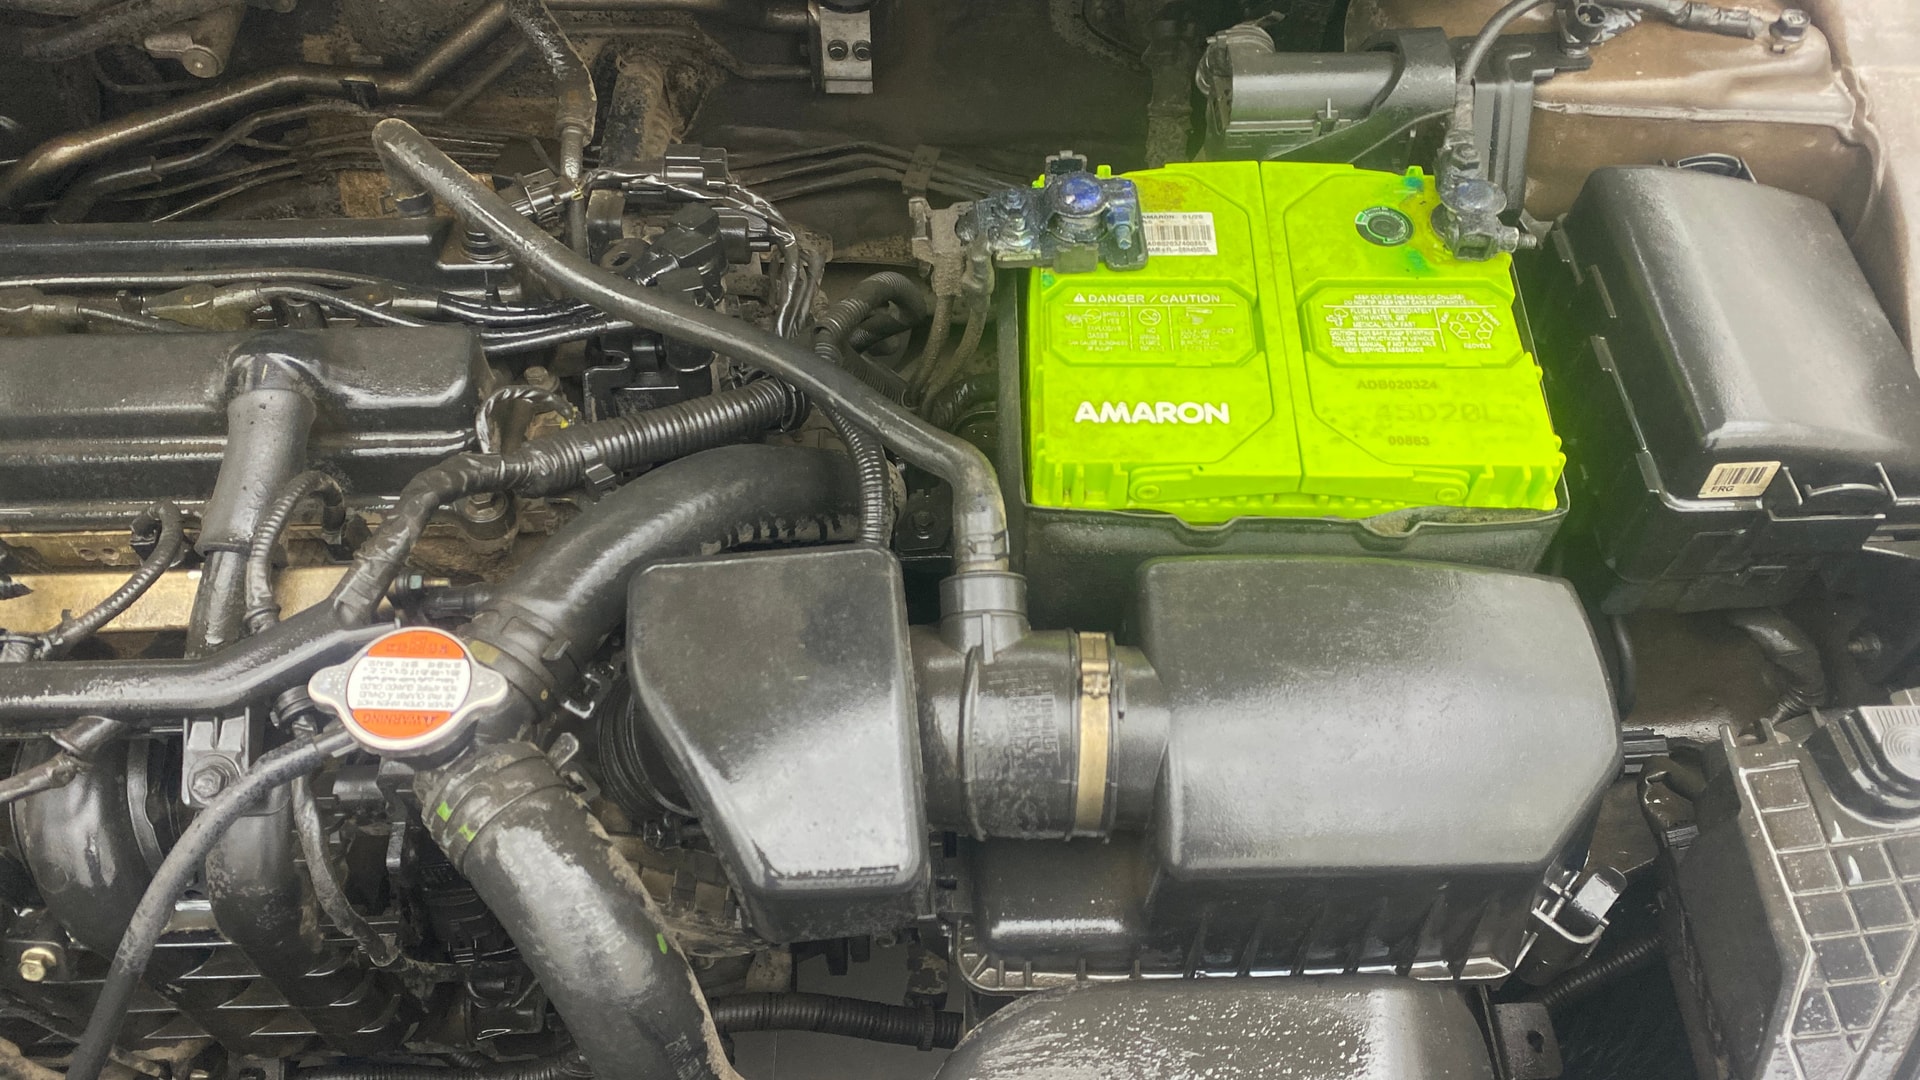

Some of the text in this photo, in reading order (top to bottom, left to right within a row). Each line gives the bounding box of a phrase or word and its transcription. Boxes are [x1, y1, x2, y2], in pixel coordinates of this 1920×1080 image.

[1088, 294, 1220, 304] DANGER / CAUTION
[1074, 401, 1230, 424] AMARON
[363, 713, 422, 726] WARNING
